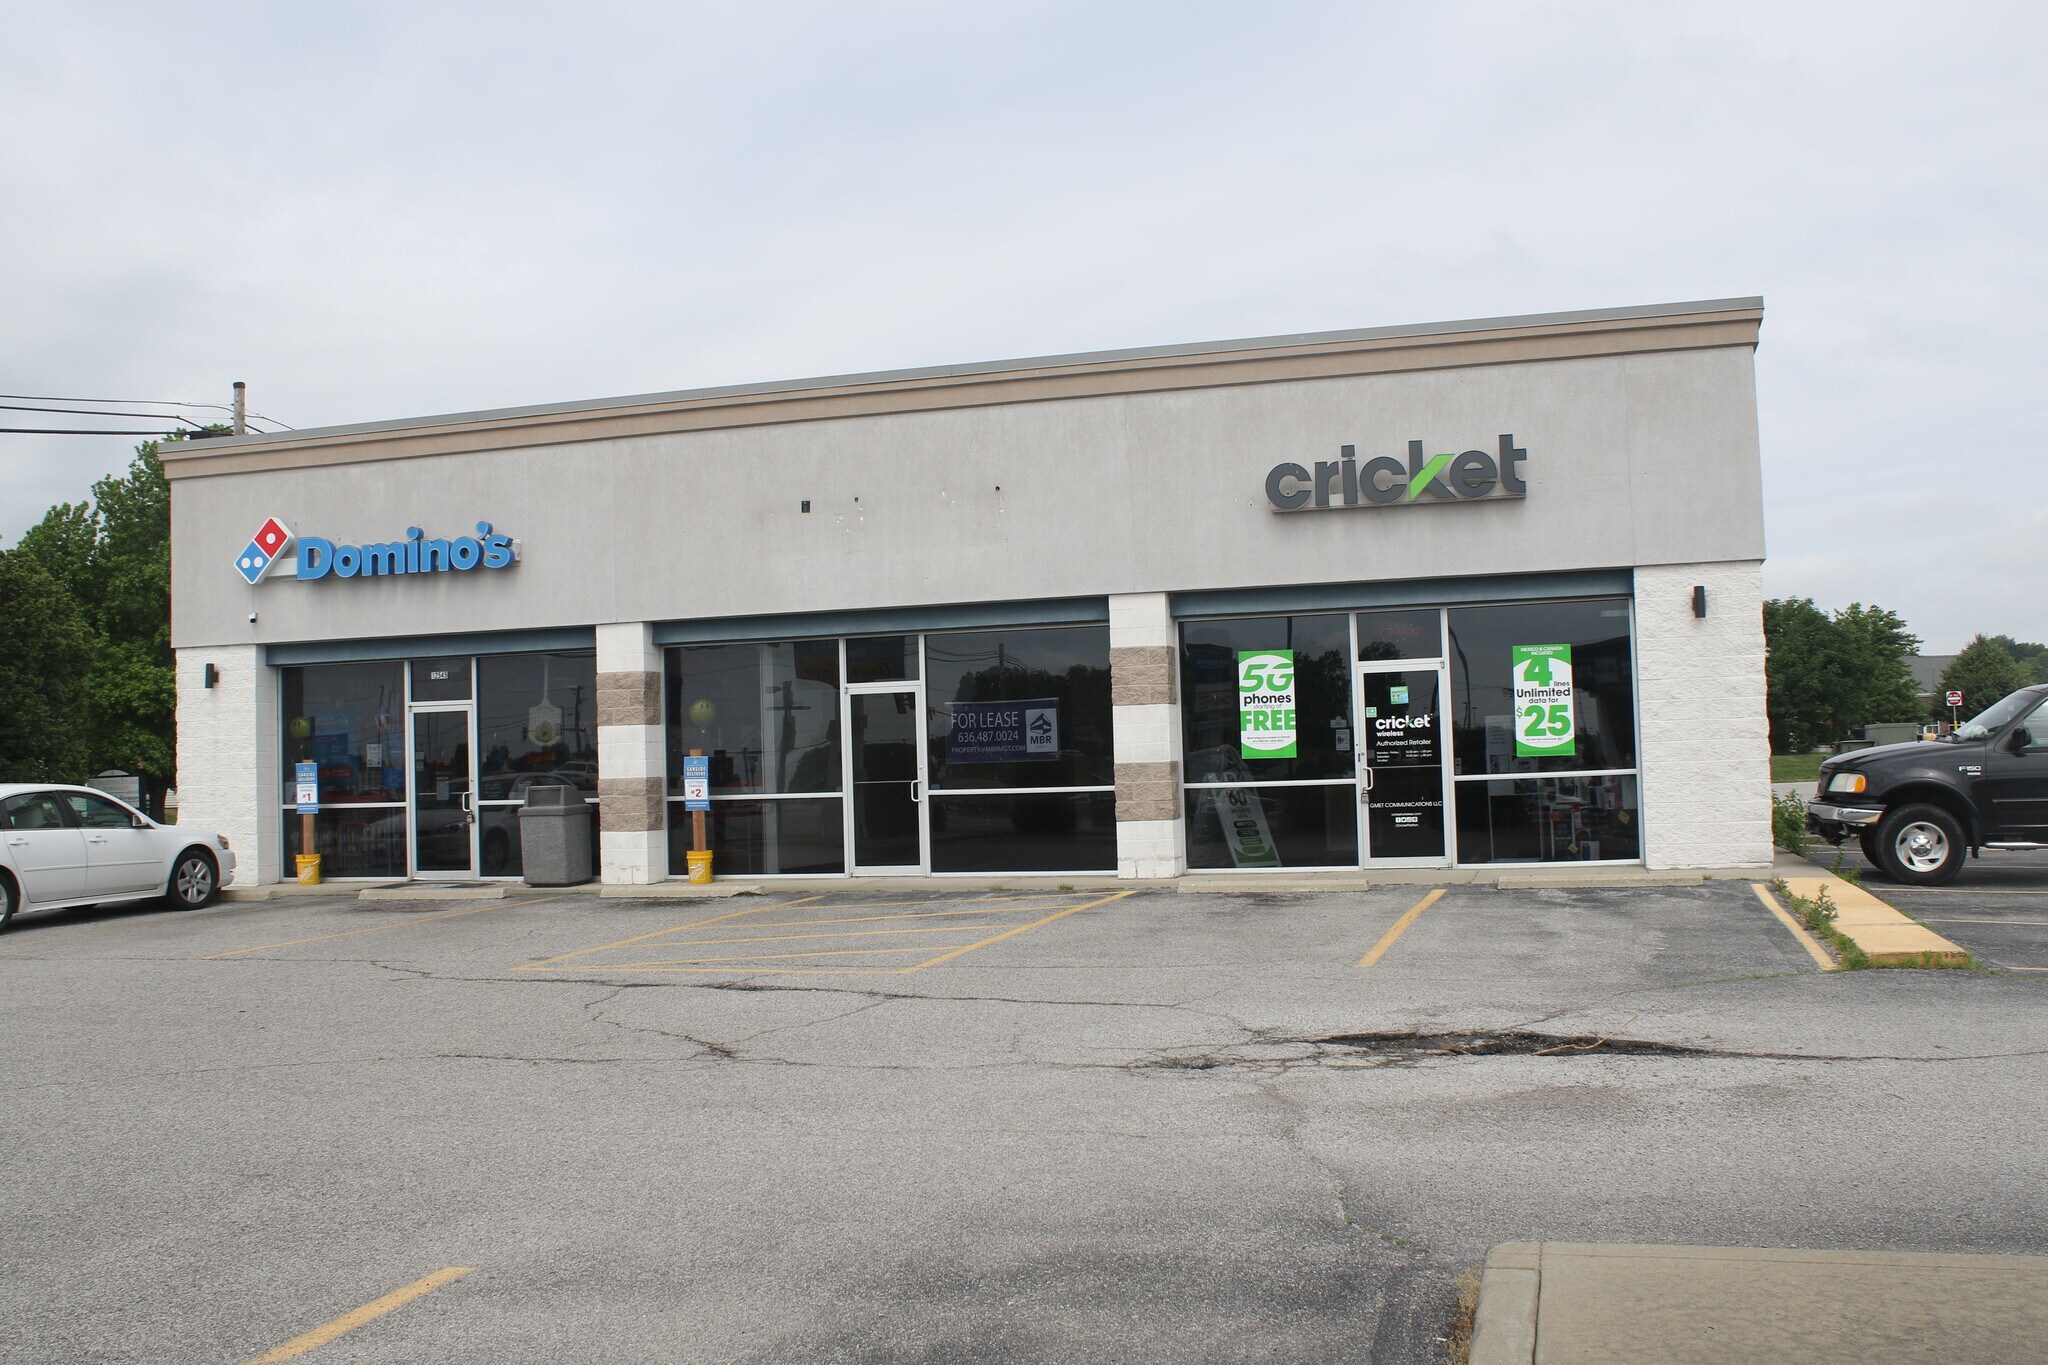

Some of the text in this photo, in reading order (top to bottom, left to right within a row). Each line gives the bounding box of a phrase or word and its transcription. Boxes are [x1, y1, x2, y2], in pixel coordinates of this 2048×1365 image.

[1265, 434, 1527, 510] cricket
[297, 521, 514, 581] Domino's
[1239, 663, 1294, 692] 5G
[1524, 656, 1552, 687] 4
[1244, 694, 1292, 706] phones
[1516, 687, 1571, 698] Unlimited
[951, 711, 1019, 729] FOR LEASE
[1240, 709, 1296, 731] FREE
[1375, 714, 1431, 729] cricket
[1516, 704, 1571, 737] $25
[958, 730, 1019, 743] 636.487.0024
[1030, 735, 1052, 745] MBR
